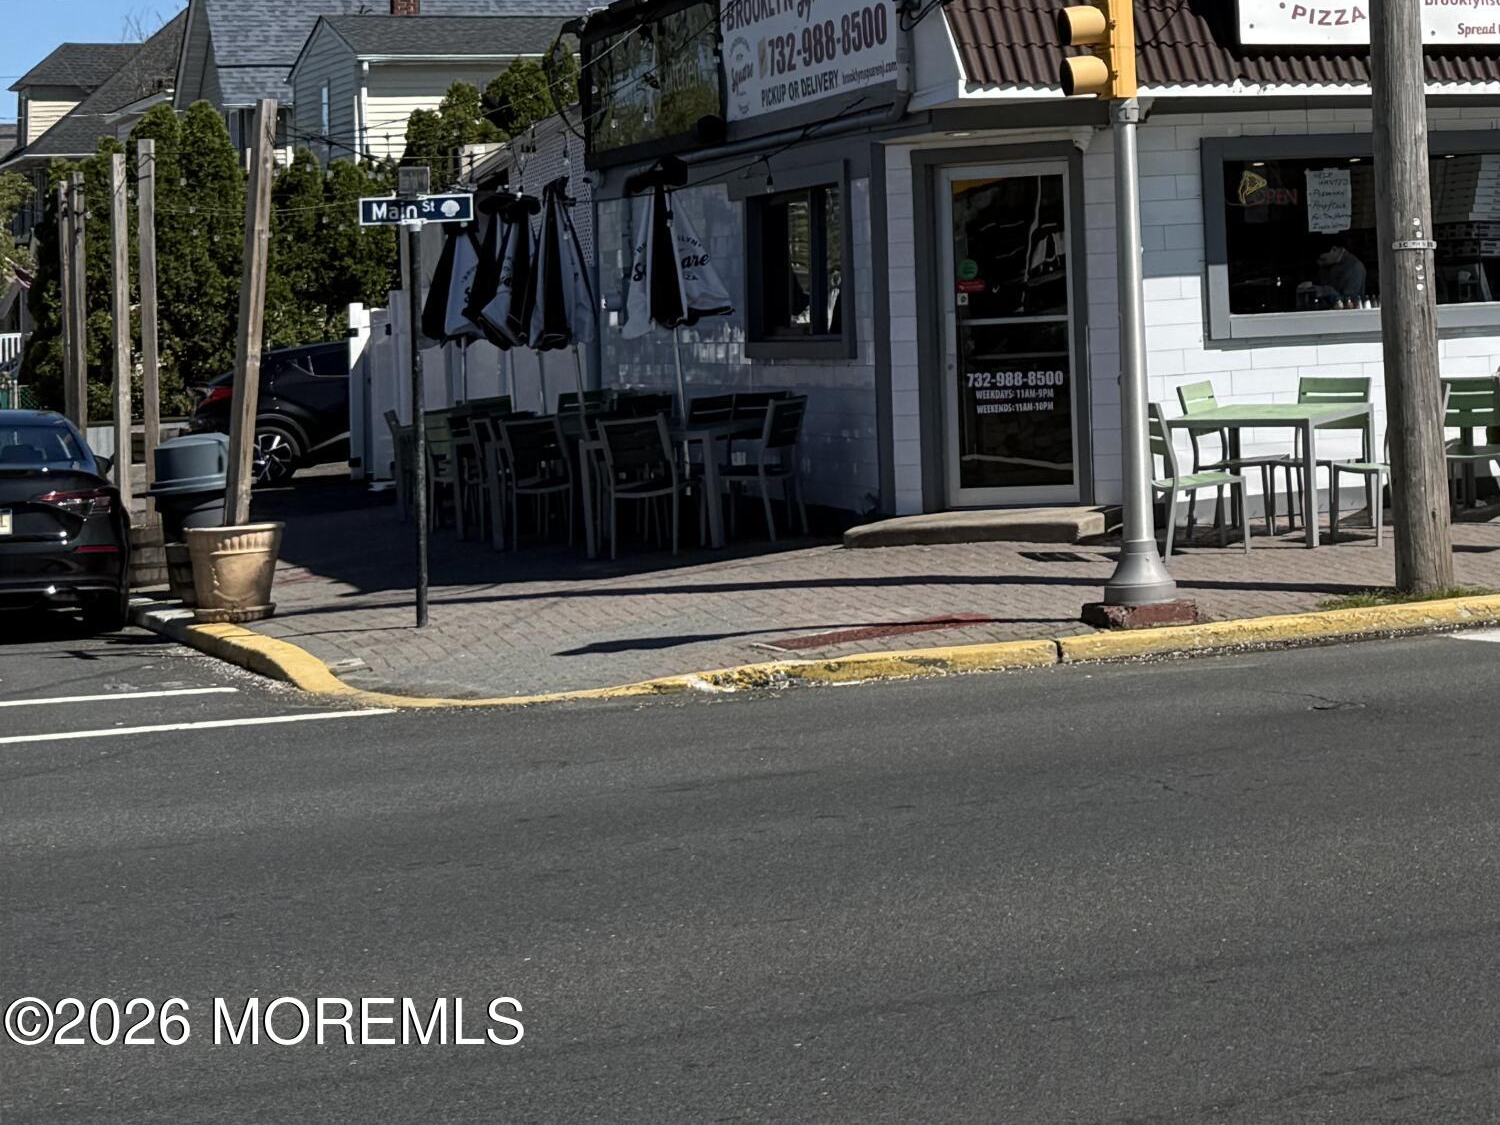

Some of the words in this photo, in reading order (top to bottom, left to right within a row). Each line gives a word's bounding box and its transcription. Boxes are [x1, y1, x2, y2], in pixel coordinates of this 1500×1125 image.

[1291, 4, 1367, 26] PIZZA
[1457, 22, 1497, 38] Spread
[768, 2, 888, 78] 732-988-8500
[761, 83, 786, 108] PICKUP
[788, 80, 800, 101] OR
[800, 69, 839, 97] DELIVERY
[371, 201, 418, 221] Main
[421, 200, 436, 213] St
[966, 370, 1064, 388] 732-988-8500
[975, 389, 1015, 400] WEEKDAYS:
[1016, 388, 1055, 399] 11AM-9PM
[976, 403, 1015, 414] WEEKENDS:
[1015, 401, 1055, 412] 11AM-10PM
